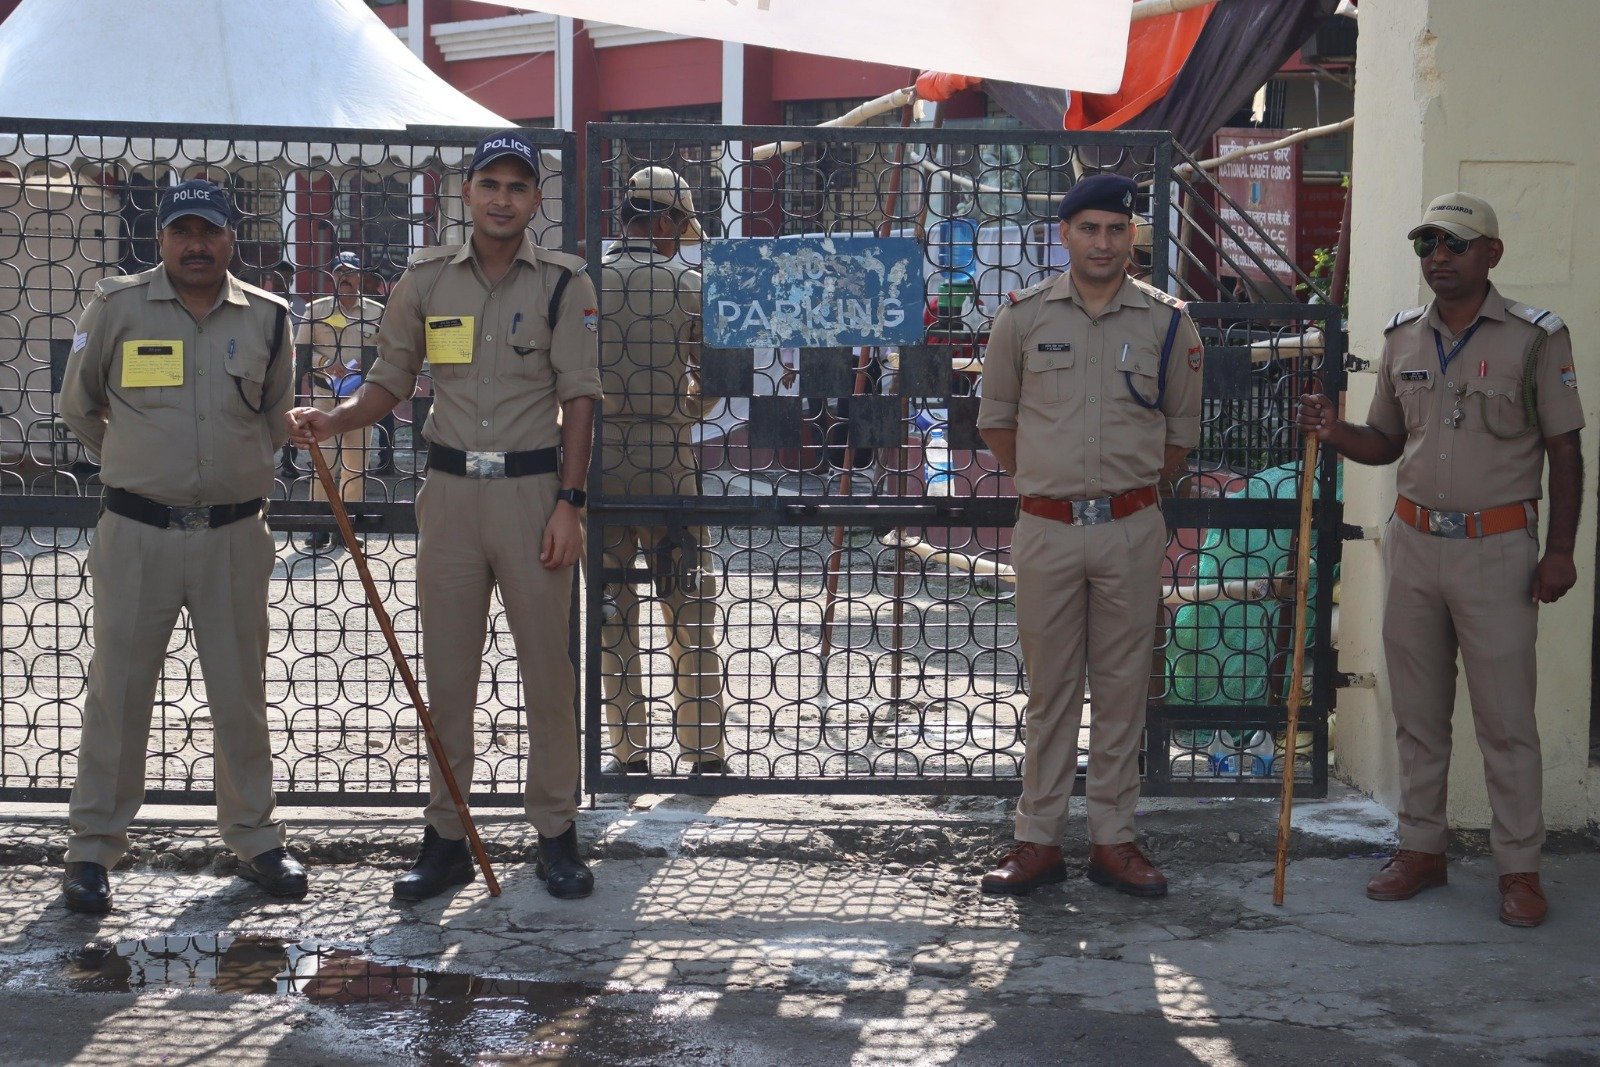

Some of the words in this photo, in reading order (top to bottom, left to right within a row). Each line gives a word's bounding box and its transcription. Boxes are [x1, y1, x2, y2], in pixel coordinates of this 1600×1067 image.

[483, 138, 531, 158] POLICE
[1219, 163, 1249, 178] NATIONAL
[1250, 164, 1270, 179] CADET
[1270, 164, 1291, 180] CORPS
[173, 189, 211, 203] POLICE
[717, 298, 905, 331] PARKING
